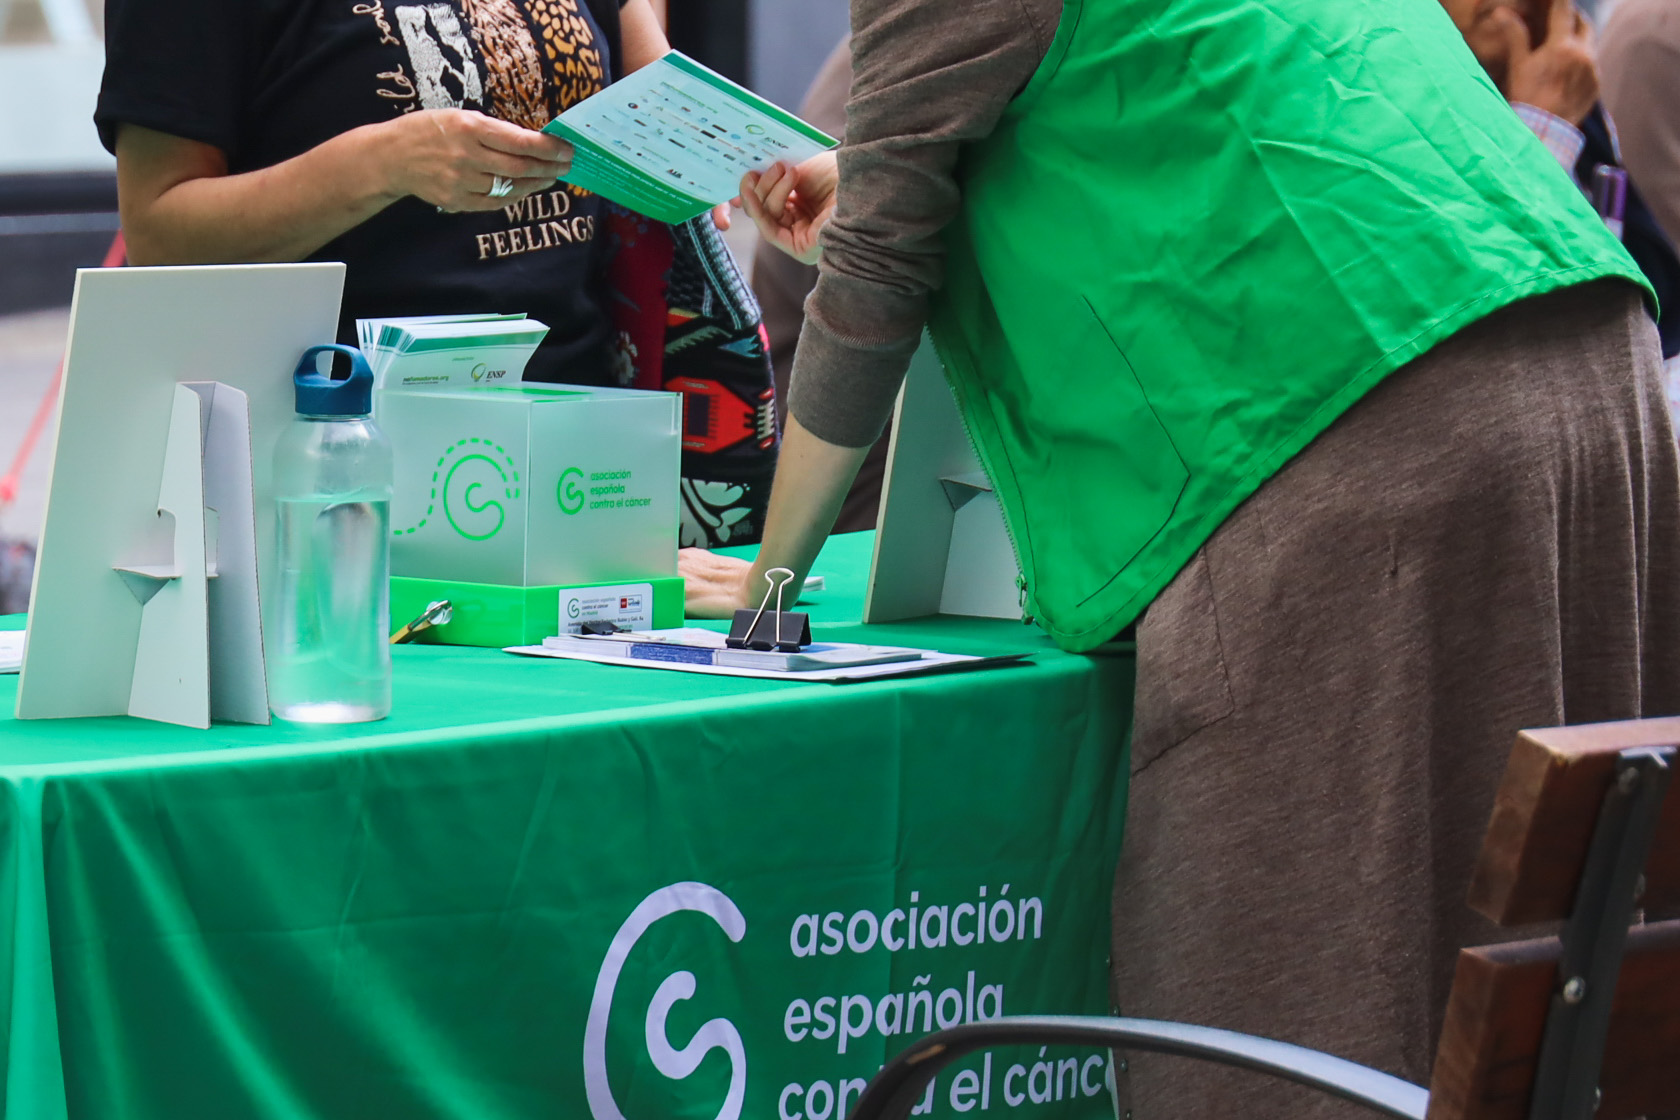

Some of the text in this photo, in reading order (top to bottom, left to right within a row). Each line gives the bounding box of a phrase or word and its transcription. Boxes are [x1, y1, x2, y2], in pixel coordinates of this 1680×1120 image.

[504, 191, 570, 223] WILD
[476, 215, 594, 259] FEELINGS
[486, 370, 506, 379] ENSP
[590, 484, 626, 496] española
[591, 469, 632, 480] asociación
[590, 499, 614, 510] contra
[616, 498, 624, 507] el
[790, 884, 1042, 958] asociación
[784, 970, 1003, 1054] española
[949, 1052, 992, 1113] el
